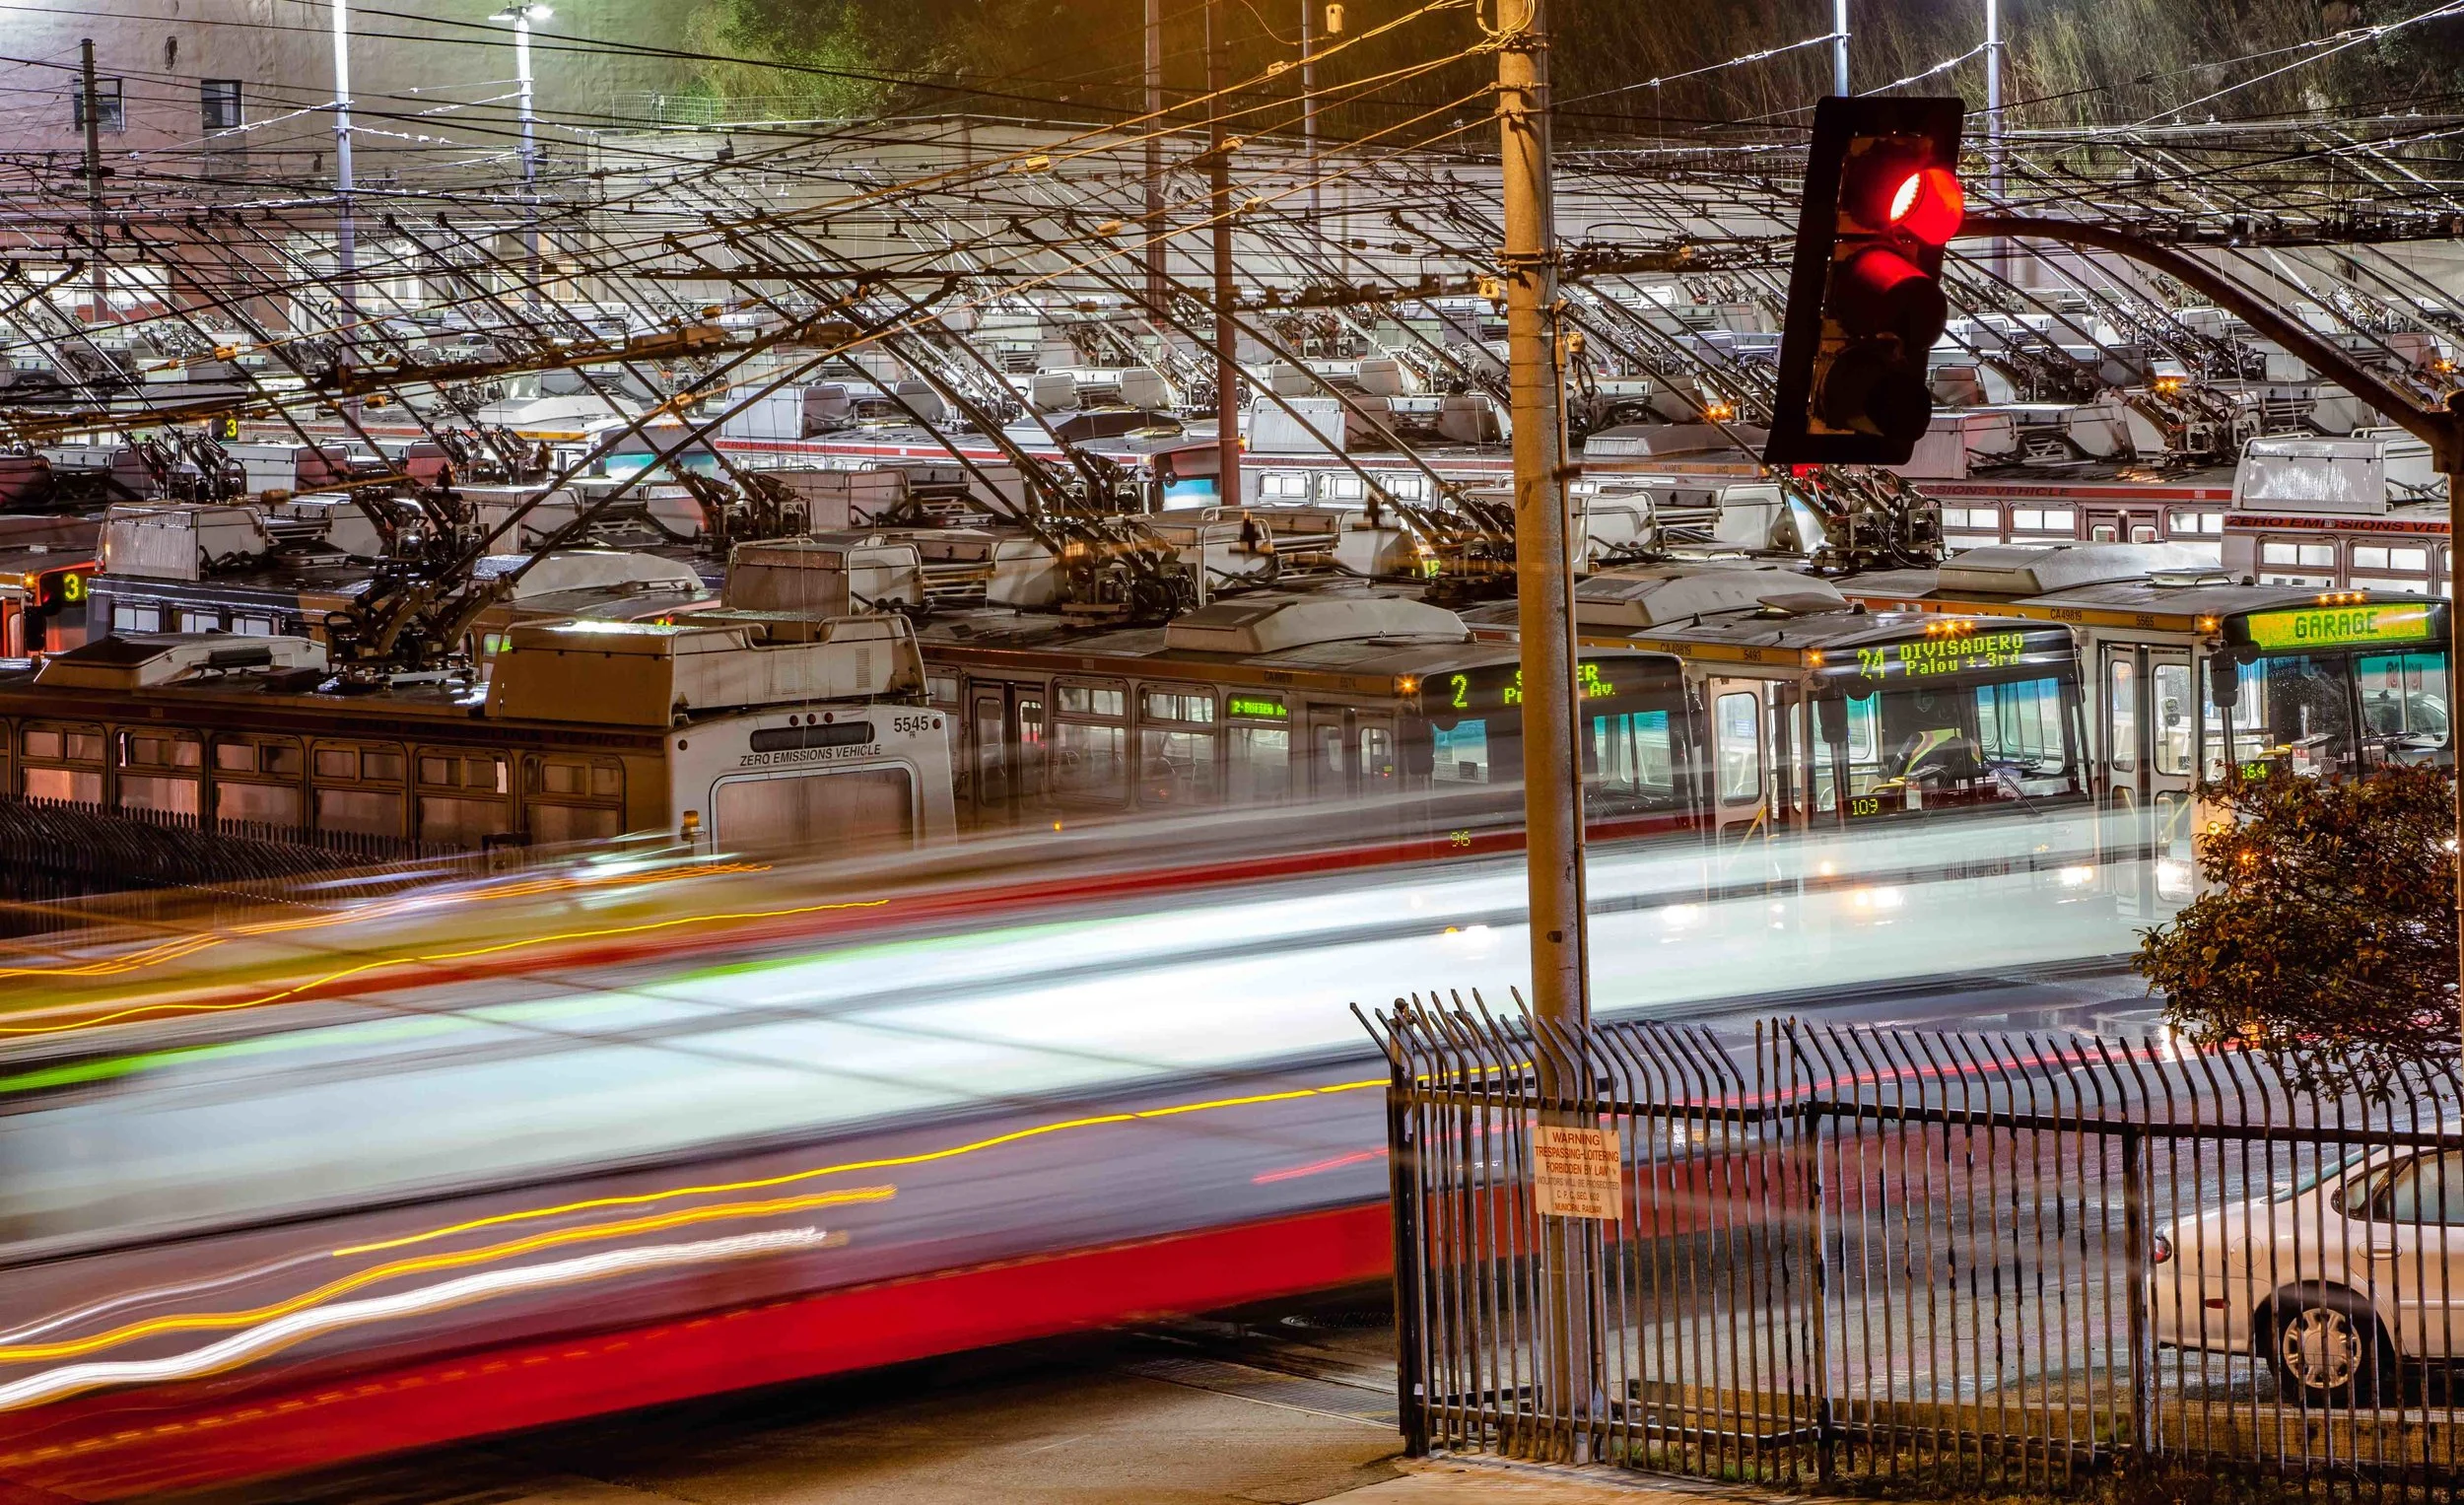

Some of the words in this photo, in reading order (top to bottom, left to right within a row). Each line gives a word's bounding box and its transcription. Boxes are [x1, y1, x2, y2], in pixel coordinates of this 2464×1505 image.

[226, 418, 238, 438] 3
[1995, 486, 2069, 497] VEHICLE
[2227, 515, 2284, 527] ZERO
[64, 574, 79, 599] 3
[2050, 608, 2082, 621] CA49819
[2294, 611, 2379, 639] GARAGE
[1899, 633, 2024, 660] DIVISADERO
[1857, 647, 1885, 680] 24
[1905, 657, 1958, 676] Palou
[1985, 650, 2020, 667] 3rd
[1451, 674, 1468, 708] 2
[1589, 681, 1616, 698] Av.
[893, 716, 929, 733] 5545
[740, 753, 770, 767] ZERO
[773, 748, 833, 764] EMISSIONS
[837, 744, 881, 758] VEHICLE
[1450, 831, 1471, 848] 96
[1552, 1131, 1601, 1146] WARNING
[1535, 1146, 1619, 1162] TRESPASSING-LOITERING
[1545, 1162, 1582, 1175] FORBIDDEN
[1584, 1164, 1593, 1176] BY
[1594, 1166, 1608, 1177] LAW
[1587, 1180, 1619, 1190] PROSECUTED
[1554, 1202, 1580, 1212] MUNICIPAL
[1582, 1204, 1603, 1214] RAILWAY
